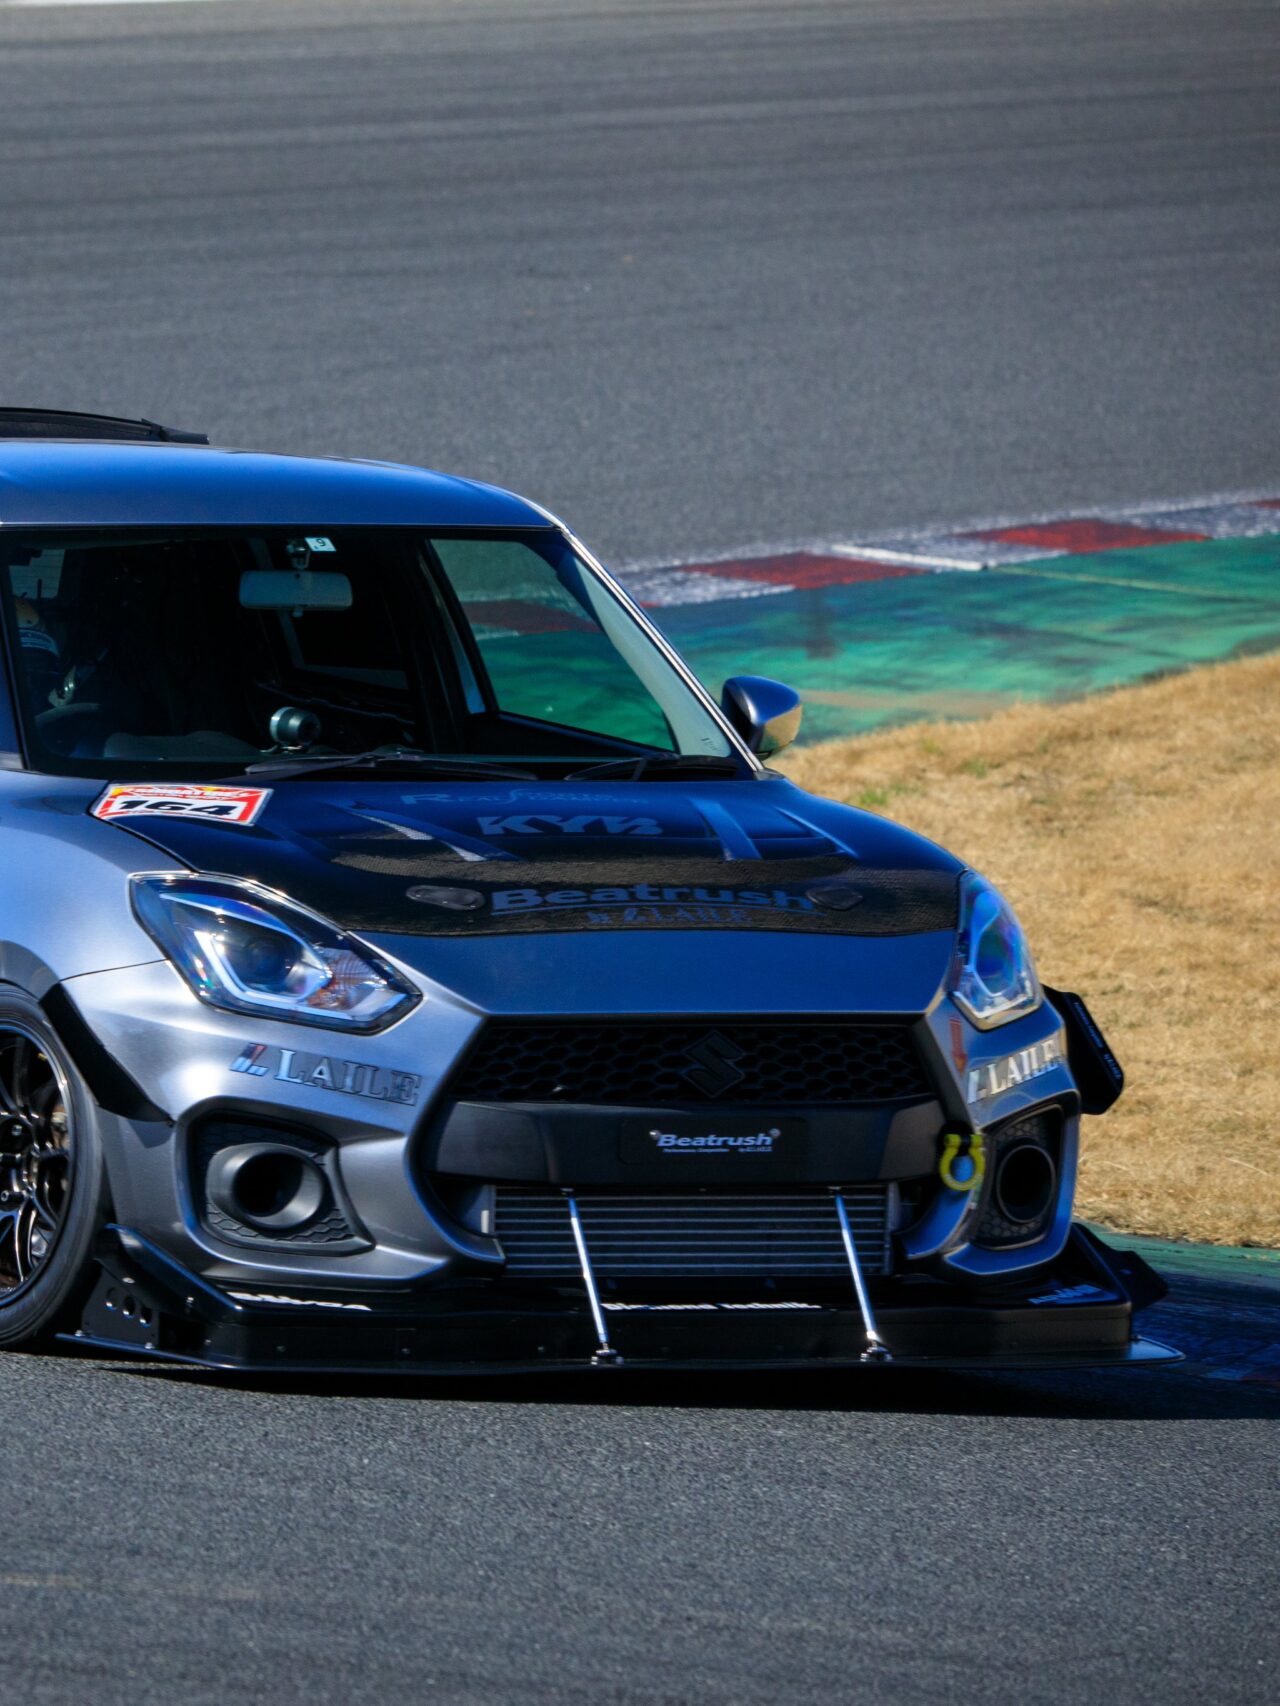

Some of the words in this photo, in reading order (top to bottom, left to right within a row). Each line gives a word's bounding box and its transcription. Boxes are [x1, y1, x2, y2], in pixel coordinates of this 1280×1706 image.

[119, 800, 239, 816] 164
[476, 814, 663, 835] KYB
[492, 884, 816, 911] Beatrush
[275, 1048, 422, 1107] LAILE
[987, 1039, 1060, 1095] LAILE
[656, 1132, 773, 1147] Beatrush
